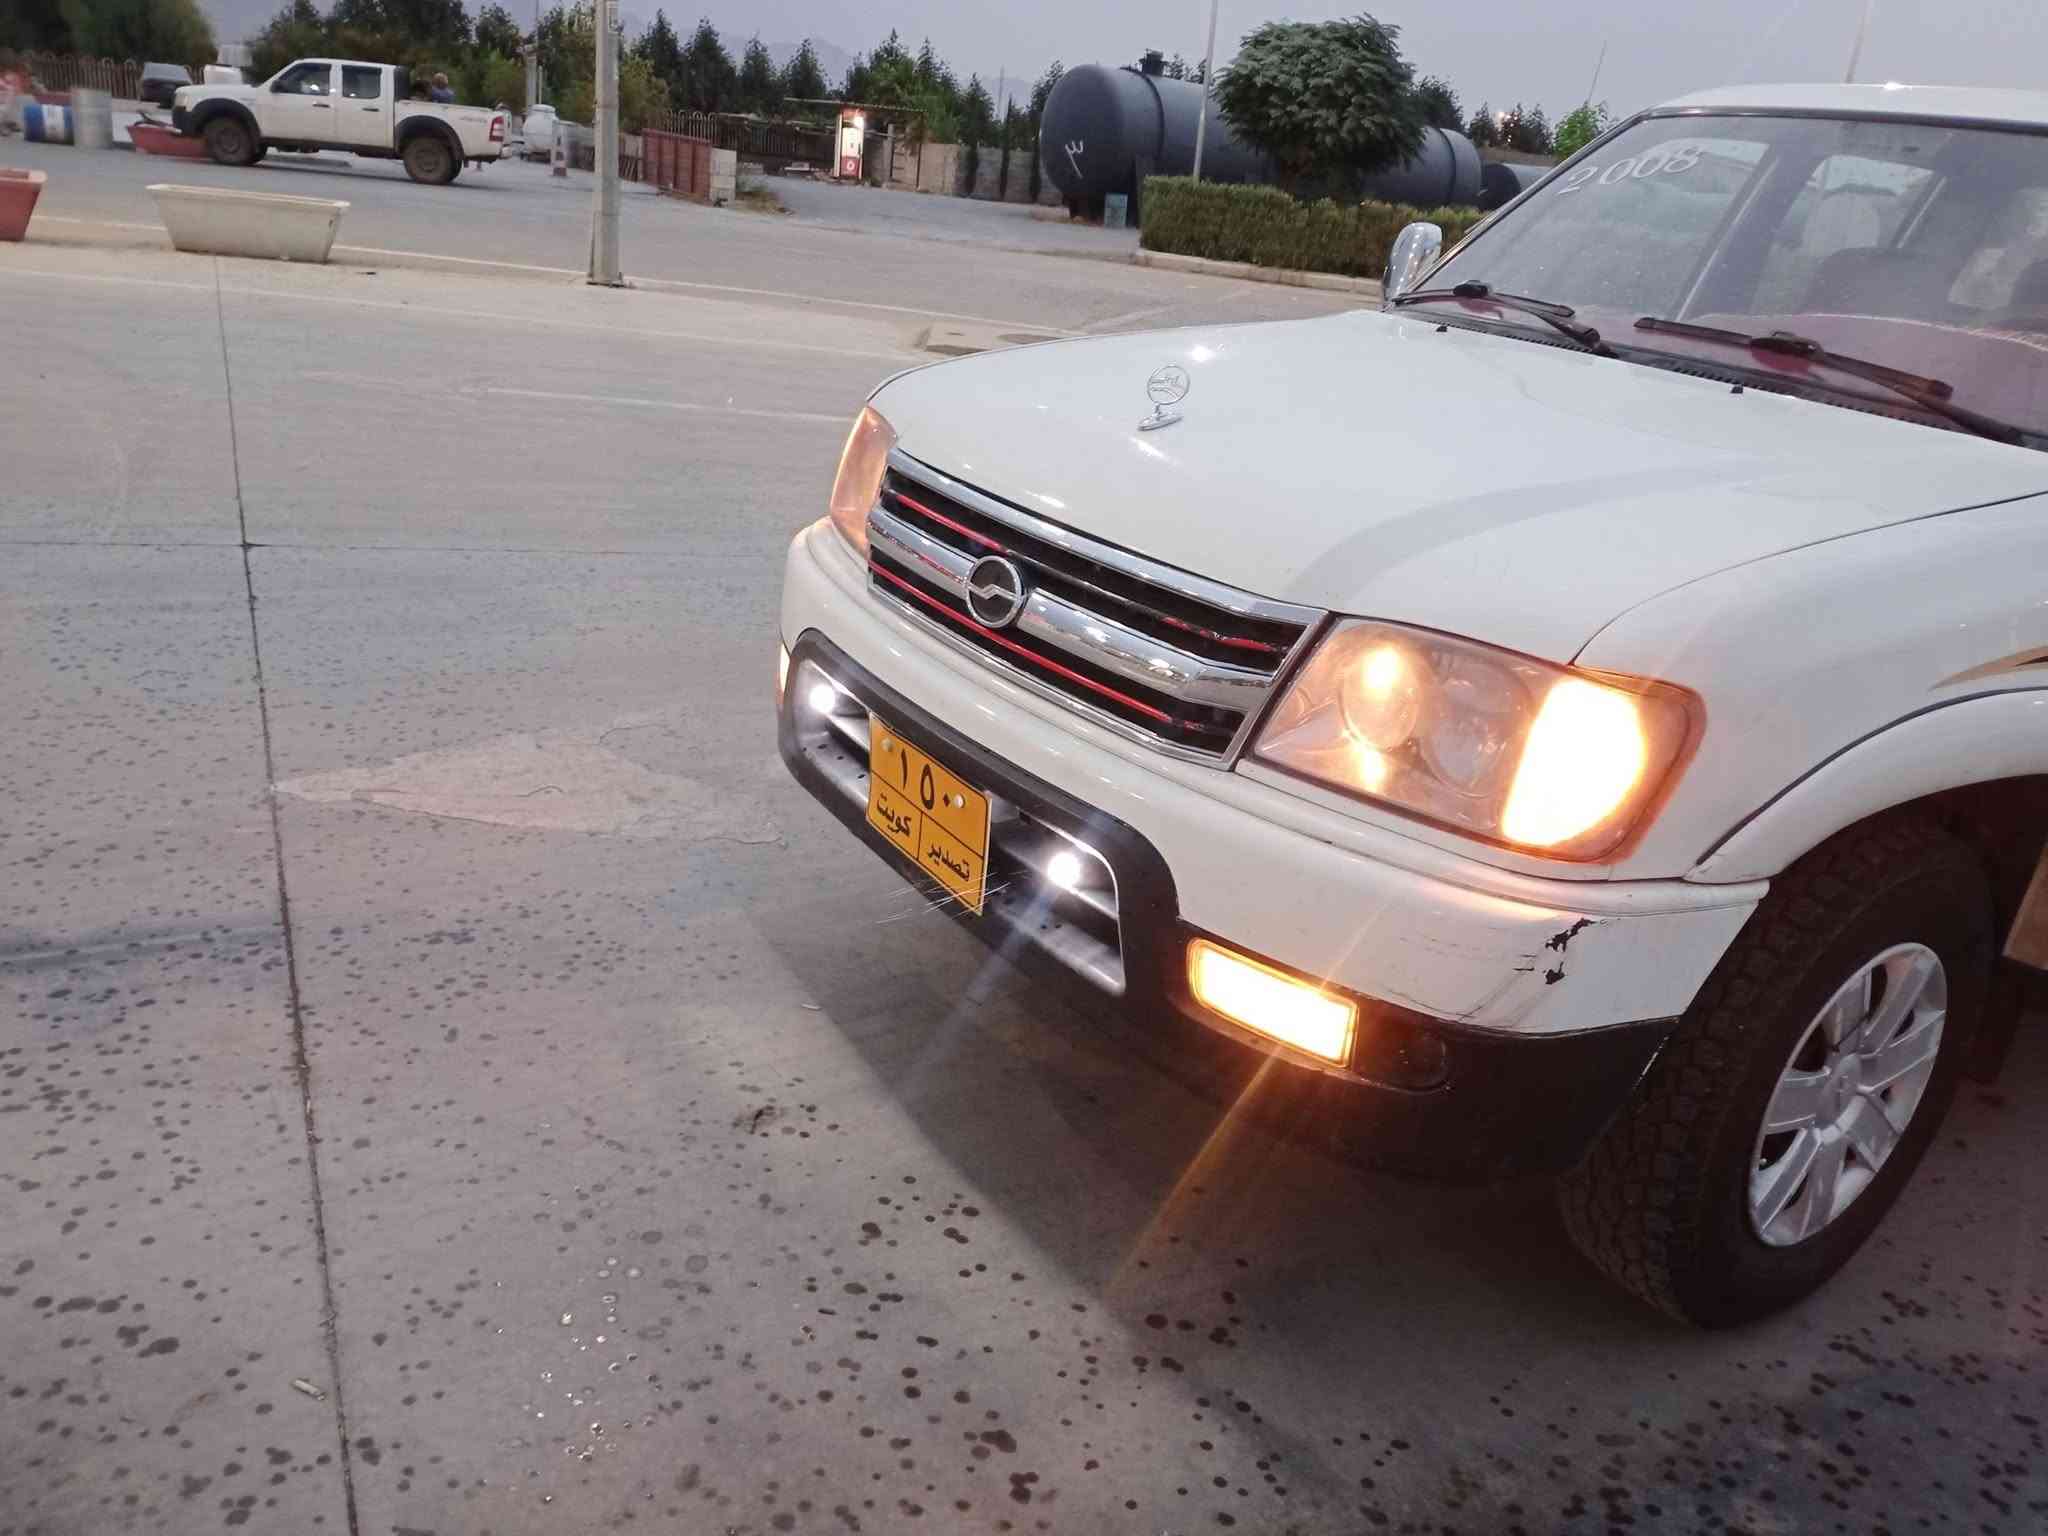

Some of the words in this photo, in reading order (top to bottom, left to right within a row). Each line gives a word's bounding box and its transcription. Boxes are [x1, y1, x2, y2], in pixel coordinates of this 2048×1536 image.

[1558, 145, 1706, 195] 2008
[900, 748, 951, 810] ١٥٠
[877, 794, 912, 837] كويت
[928, 843, 971, 882] تصدير
